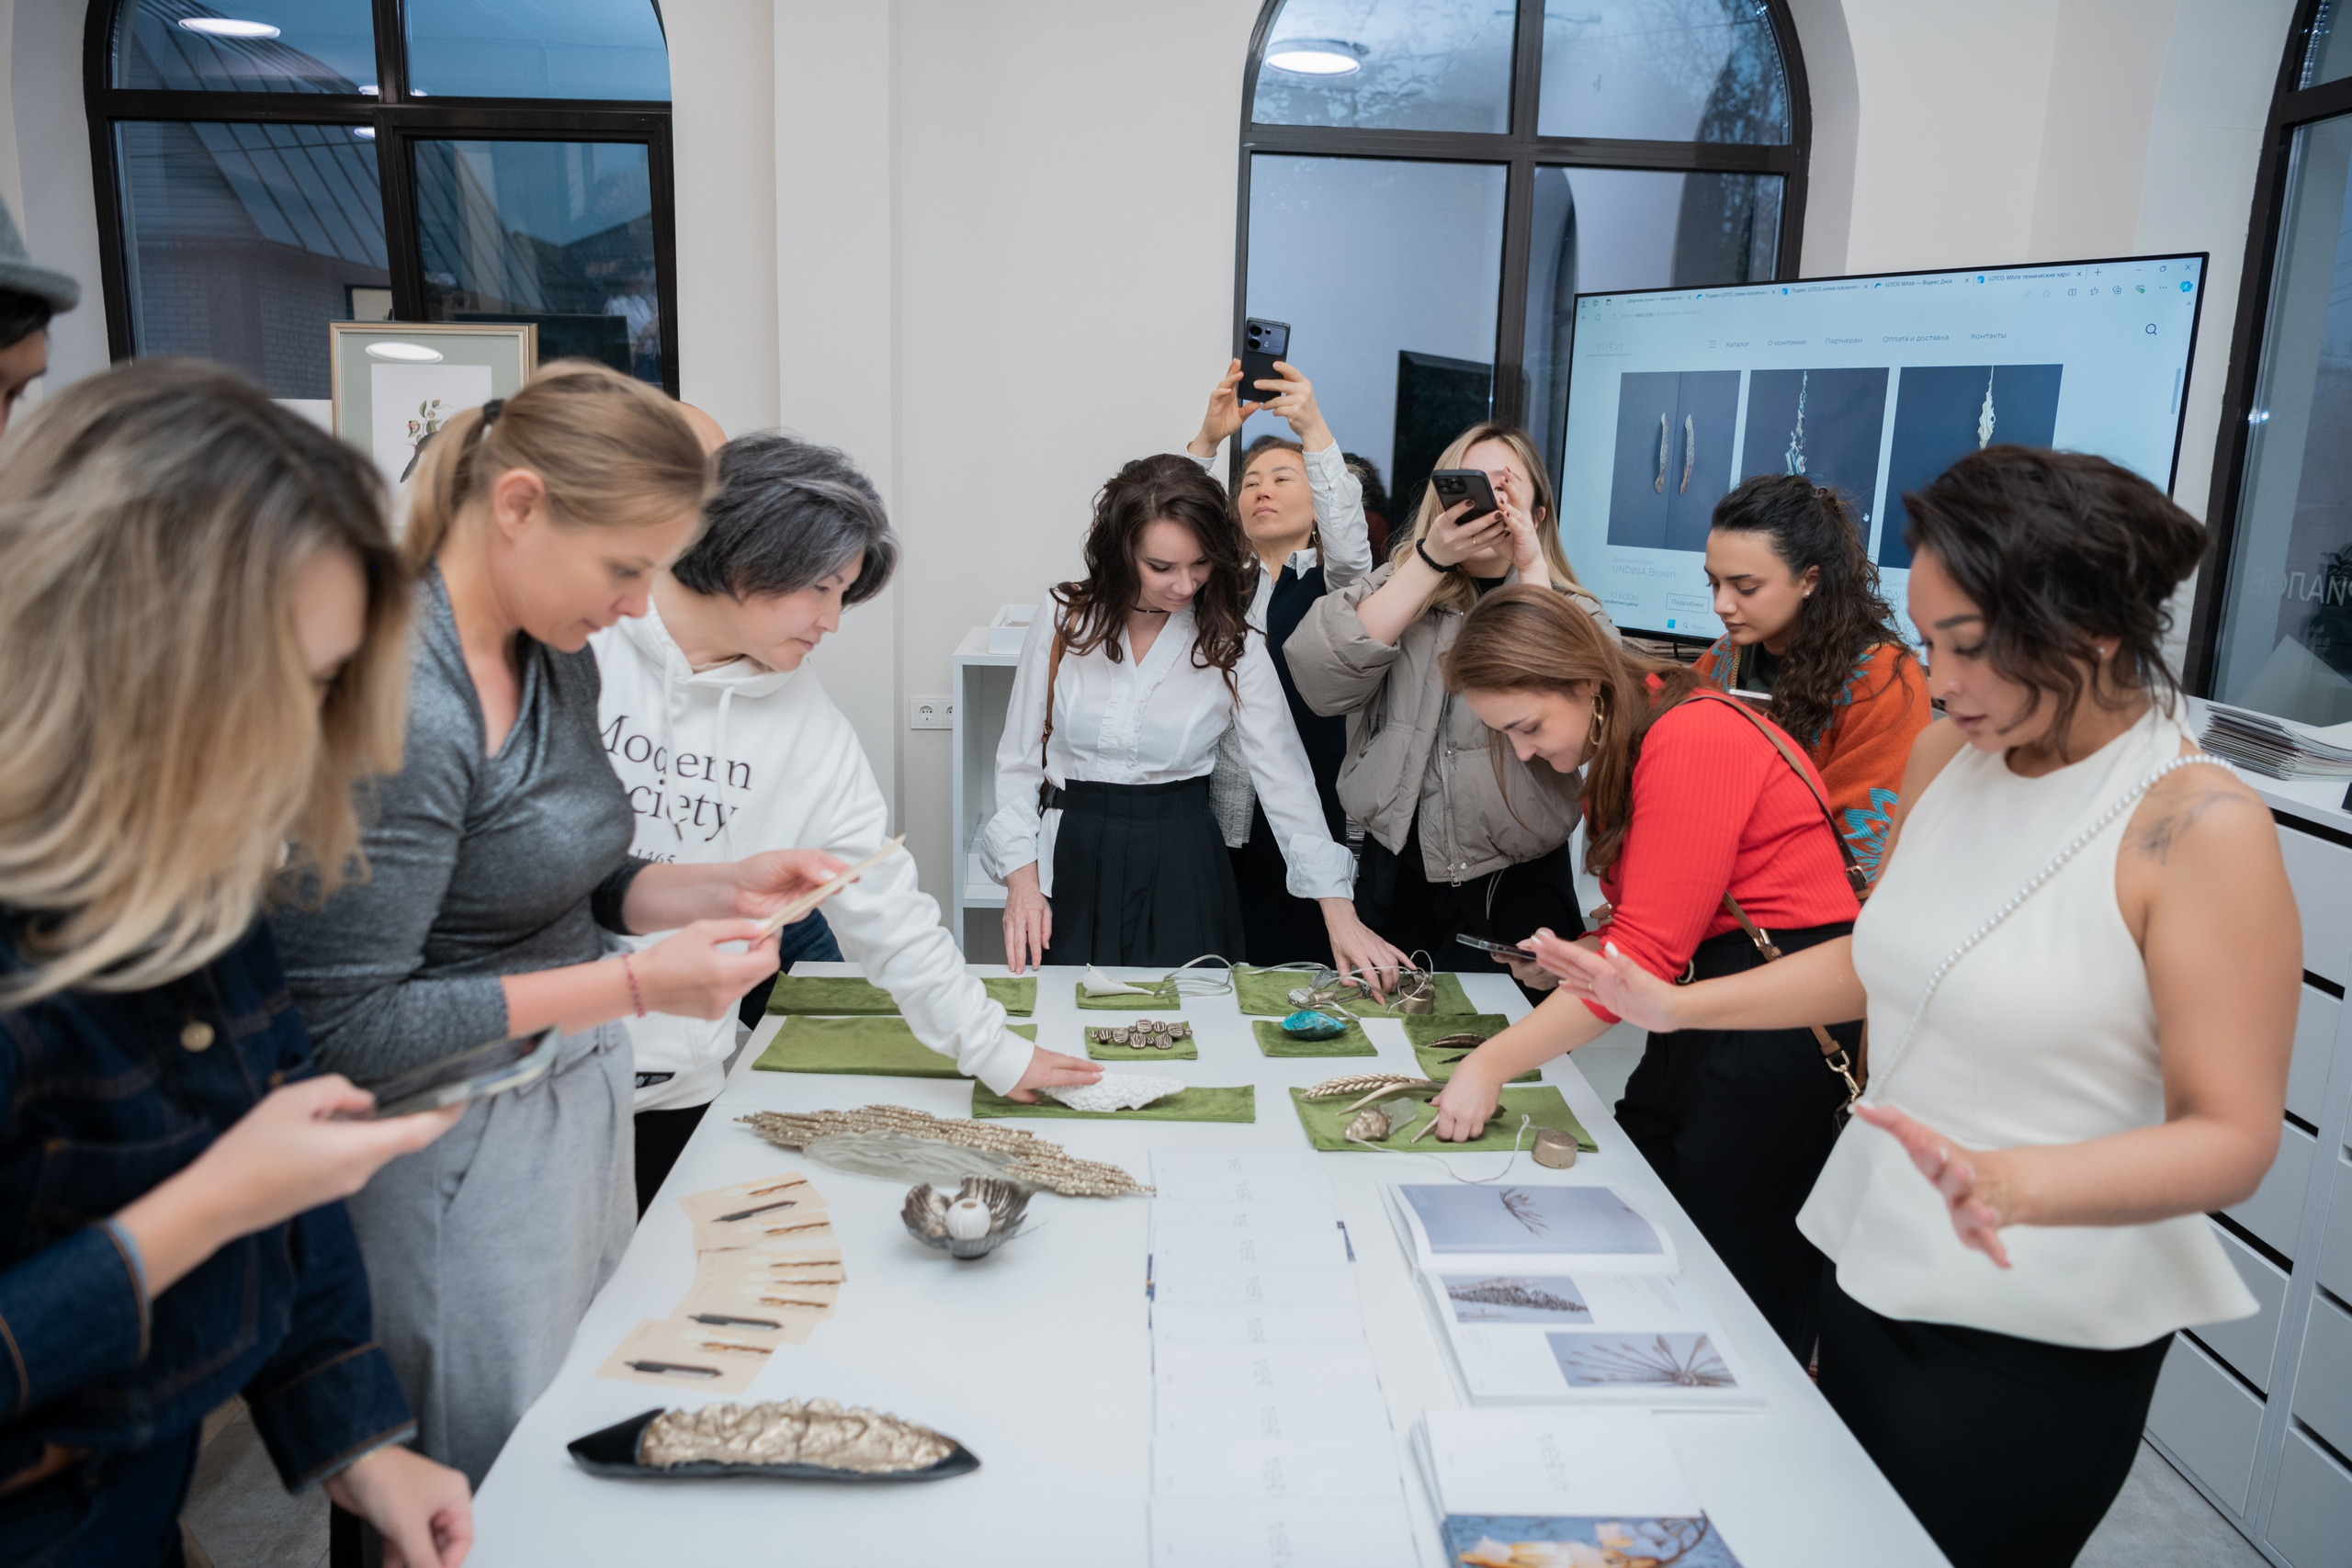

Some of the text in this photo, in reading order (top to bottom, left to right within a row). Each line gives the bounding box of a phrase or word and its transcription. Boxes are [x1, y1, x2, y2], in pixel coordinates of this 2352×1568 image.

[1916, 334, 1950, 343] доставка
[1971, 333, 2007, 341] Контакты
[1611, 565, 1677, 579] UNDINA Brown
[1671, 598, 1704, 608] Подробнее
[628, 779, 740, 842] ciety
